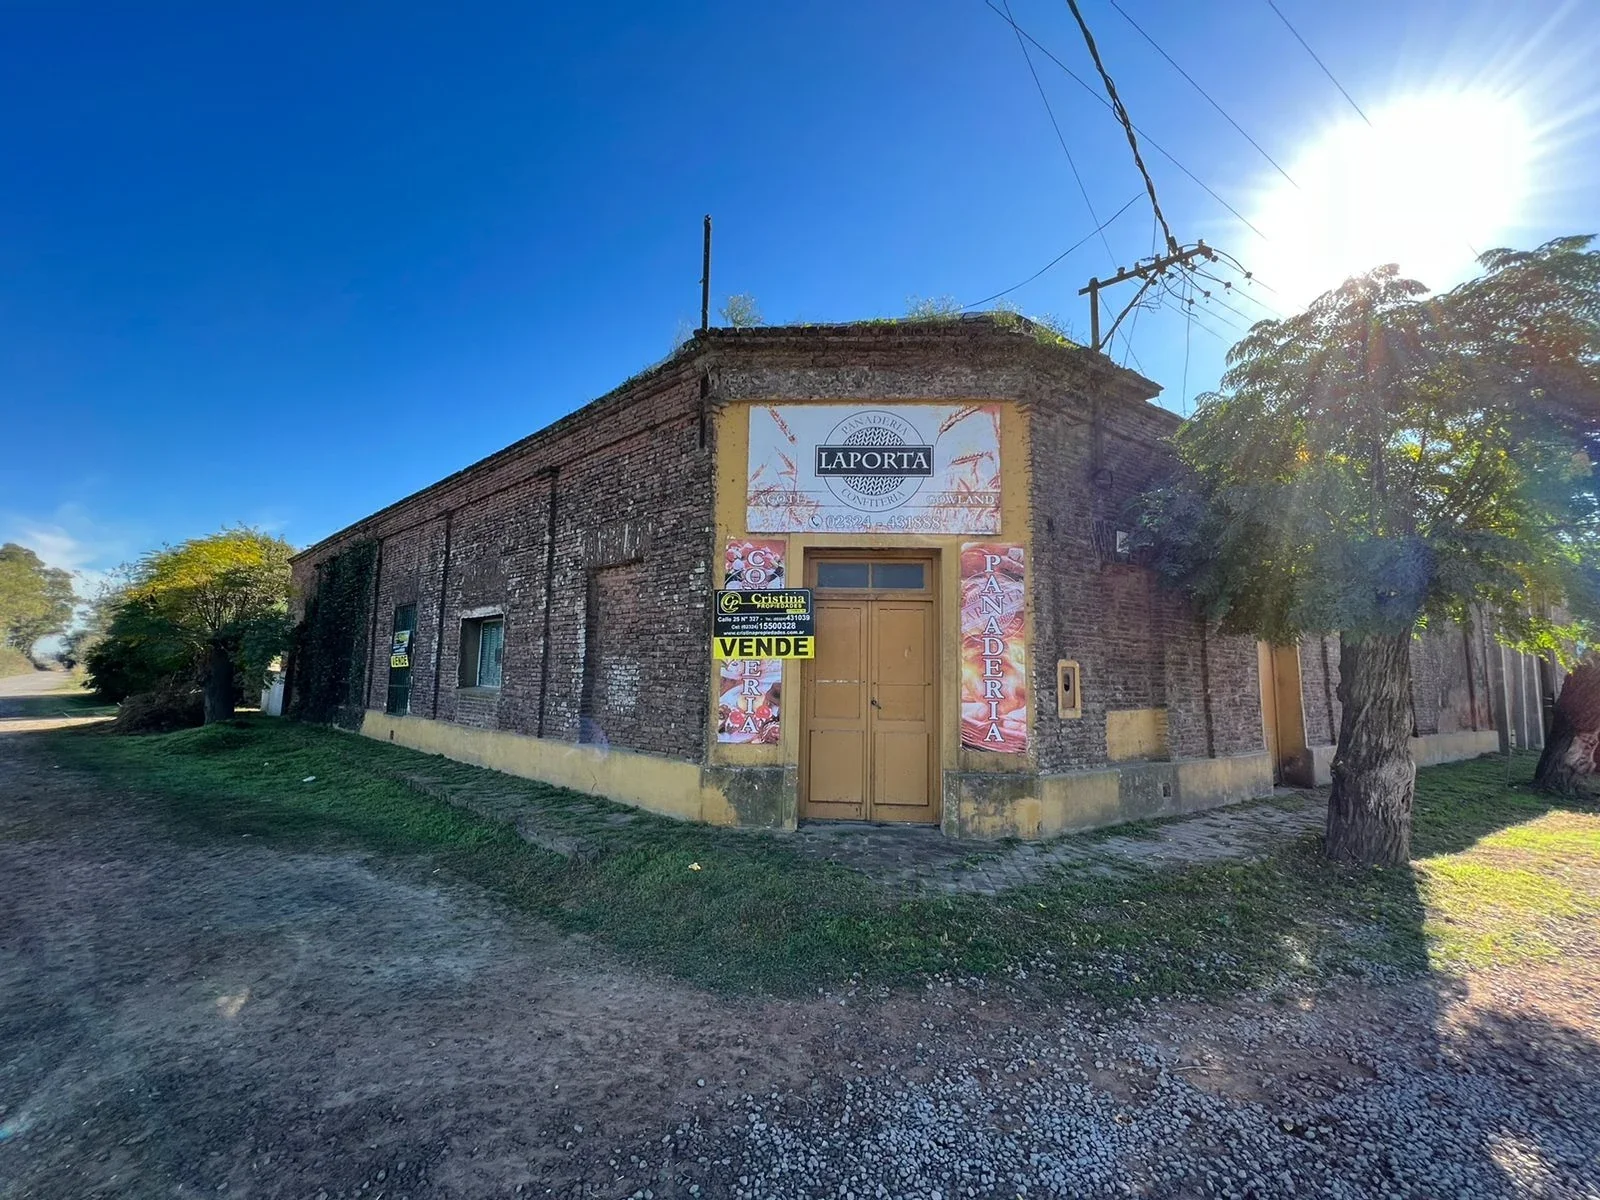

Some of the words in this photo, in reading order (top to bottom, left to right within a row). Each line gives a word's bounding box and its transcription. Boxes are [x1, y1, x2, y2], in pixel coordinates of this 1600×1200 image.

[841, 415, 908, 435] PANADERIA
[819, 451, 930, 470] LAPORTA
[841, 488, 905, 507] CONFITERIA
[926, 494, 995, 505] GOWLAND
[825, 514, 871, 529] 02324
[887, 514, 941, 529] 431888
[751, 593, 805, 604] Cristina
[759, 622, 796, 630] 15500328
[719, 638, 808, 656] VENDE
[980, 553, 1004, 742] PANADERIA
